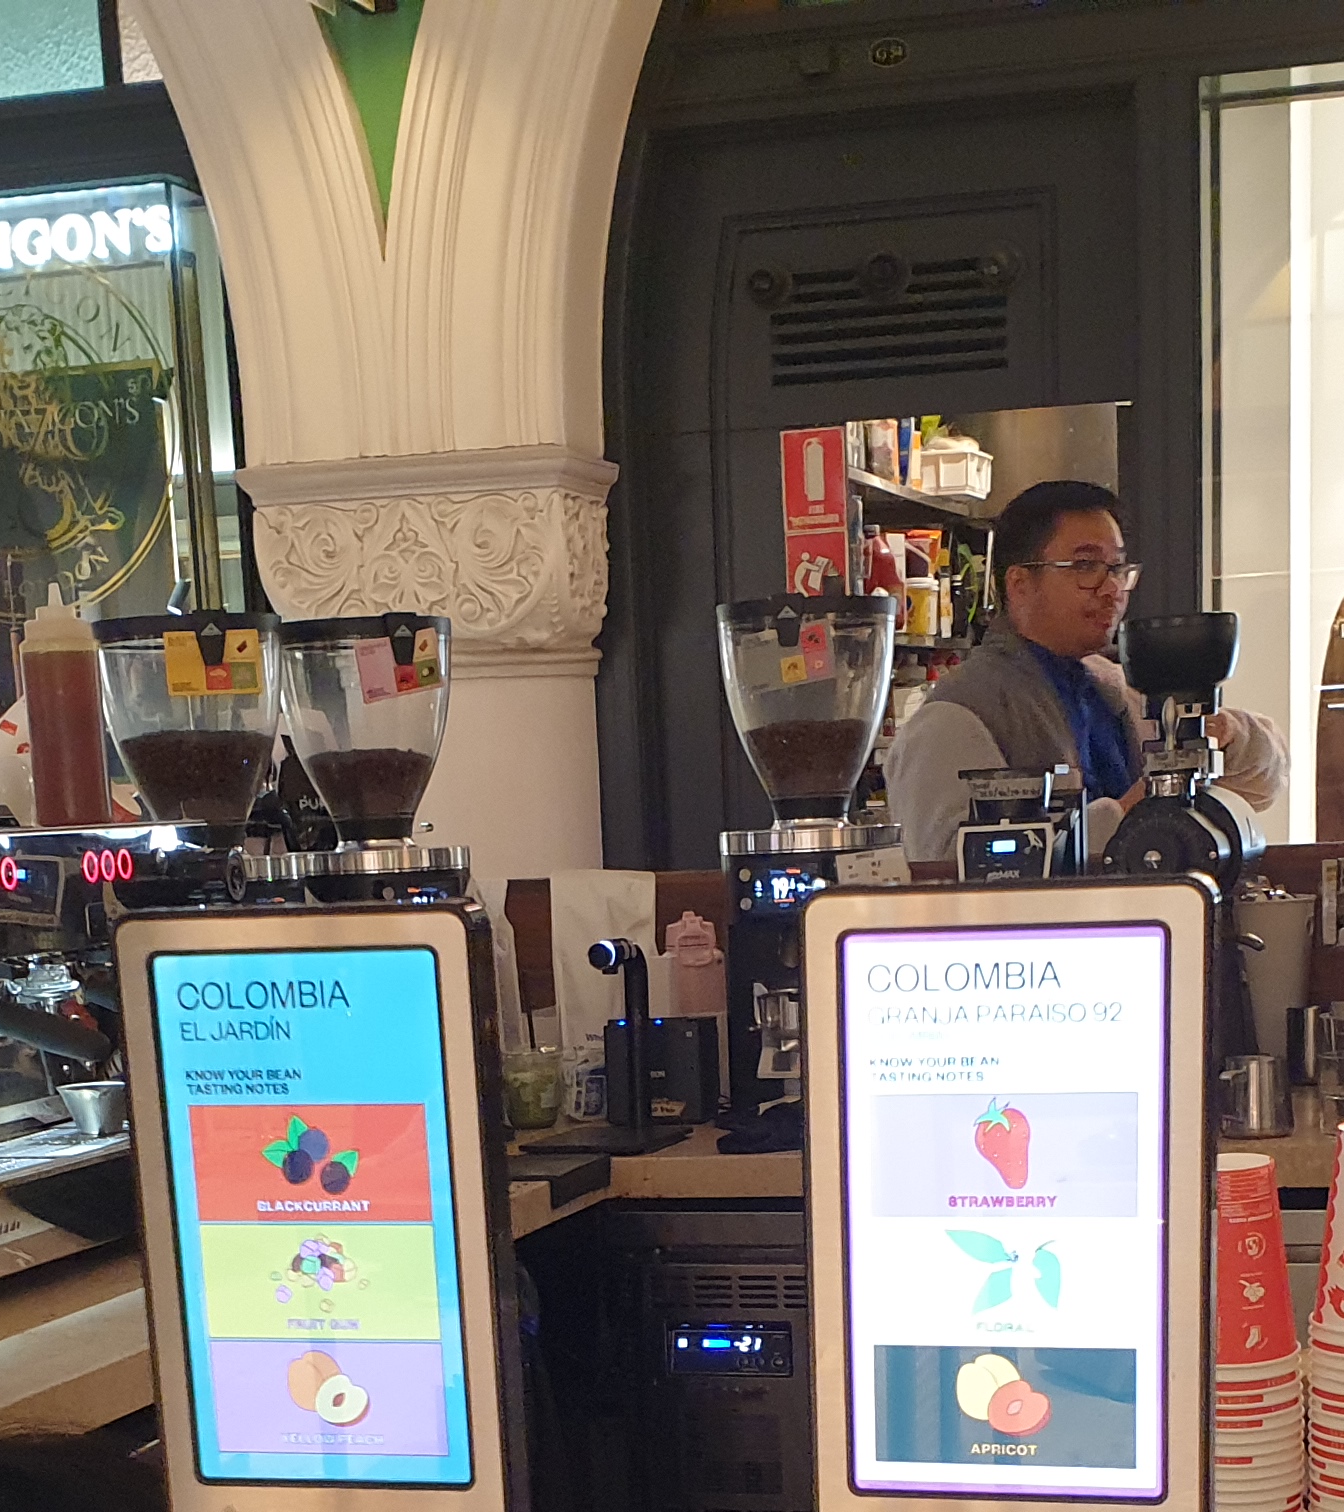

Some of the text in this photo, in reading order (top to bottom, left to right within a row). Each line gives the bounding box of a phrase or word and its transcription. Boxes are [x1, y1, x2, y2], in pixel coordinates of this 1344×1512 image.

[867, 961, 1062, 993] COLOMBIA
[177, 980, 351, 1011] COLOMBIA
[868, 1001, 1124, 1025] GRANJA PARAISO 92
[180, 1015, 292, 1042] EL JARDÍN
[869, 1056, 1001, 1068] KNOW YOUR BEAN
[185, 1069, 302, 1081] KNOW YOUR BEAN
[872, 1071, 985, 1082] TASTING NOTES
[187, 1083, 290, 1096] TASTING NOTES
[256, 1199, 371, 1213] BLACKCURRANT
[948, 1195, 1059, 1208] STRAWBERRY
[970, 1443, 1038, 1457] APRICOT
